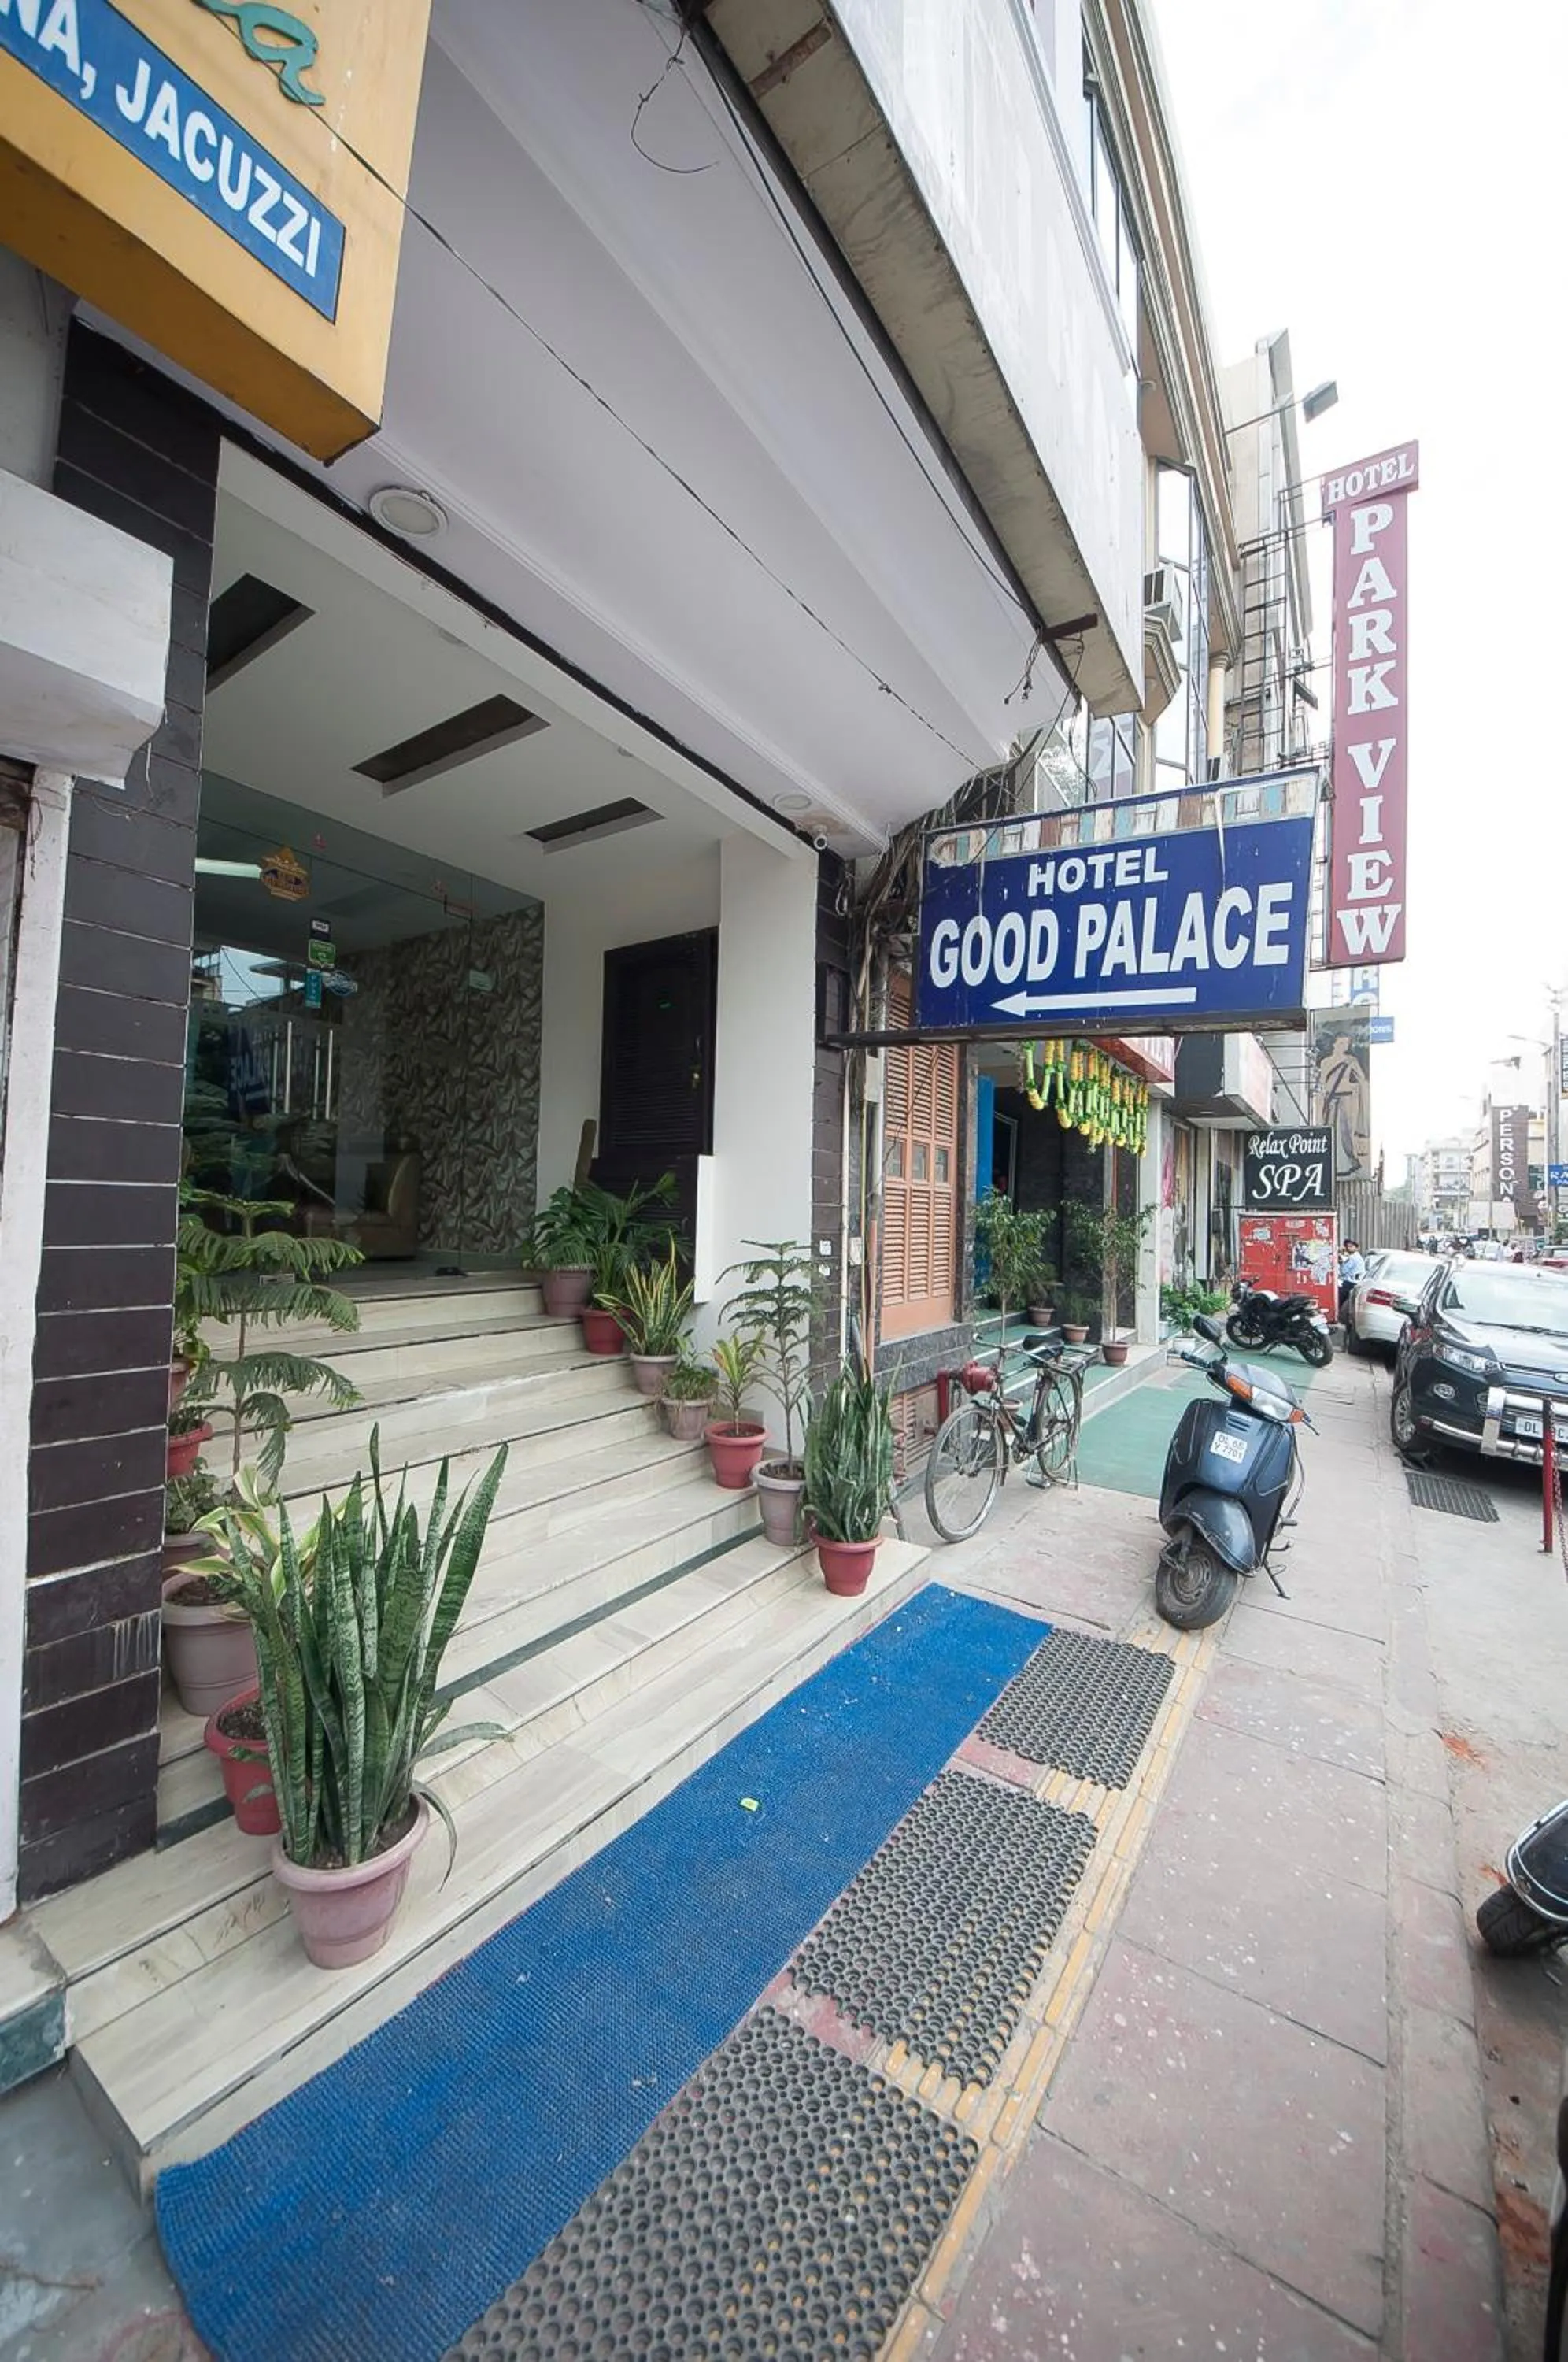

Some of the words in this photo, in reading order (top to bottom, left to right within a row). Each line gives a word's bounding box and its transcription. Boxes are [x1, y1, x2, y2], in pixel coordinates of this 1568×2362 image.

[116, 58, 320, 277] JACUZZI
[1327, 453, 1415, 505] HOTEL
[1347, 503, 1398, 715] PARK
[1027, 846, 1168, 897] HOTEL
[1337, 738, 1402, 955] VIEW
[930, 909, 1059, 987] GOOD
[1074, 882, 1293, 978] PALACE
[1248, 1131, 1289, 1159] Relax
[1289, 1132, 1327, 1153] Point
[1252, 1163, 1325, 1201] SPA
